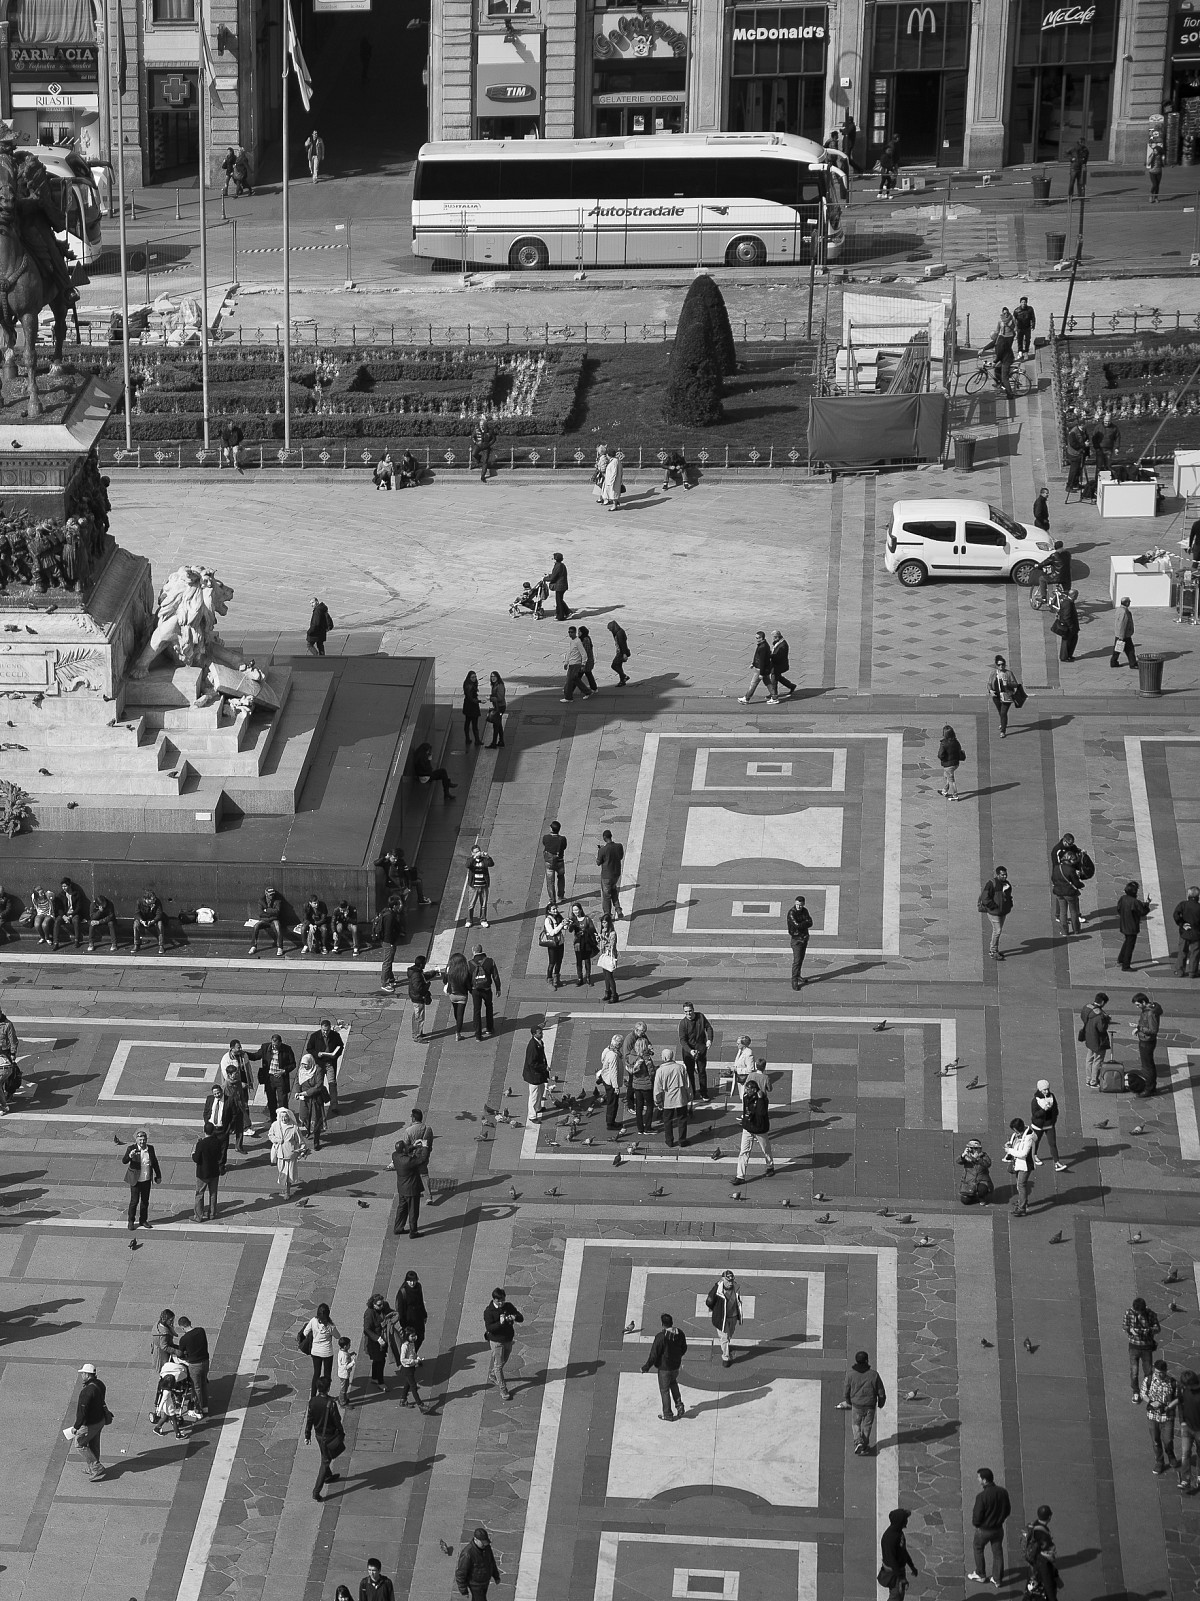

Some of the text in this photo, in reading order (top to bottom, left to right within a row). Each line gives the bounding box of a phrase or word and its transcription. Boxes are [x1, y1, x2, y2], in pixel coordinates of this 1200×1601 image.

[733, 26, 825, 41] McDonald's
[1180, 32, 1200, 45] so
[506, 87, 526, 97] TIM
[600, 94, 679, 103] GELATERIE ODEON
[588, 206, 685, 217] Autostradale
